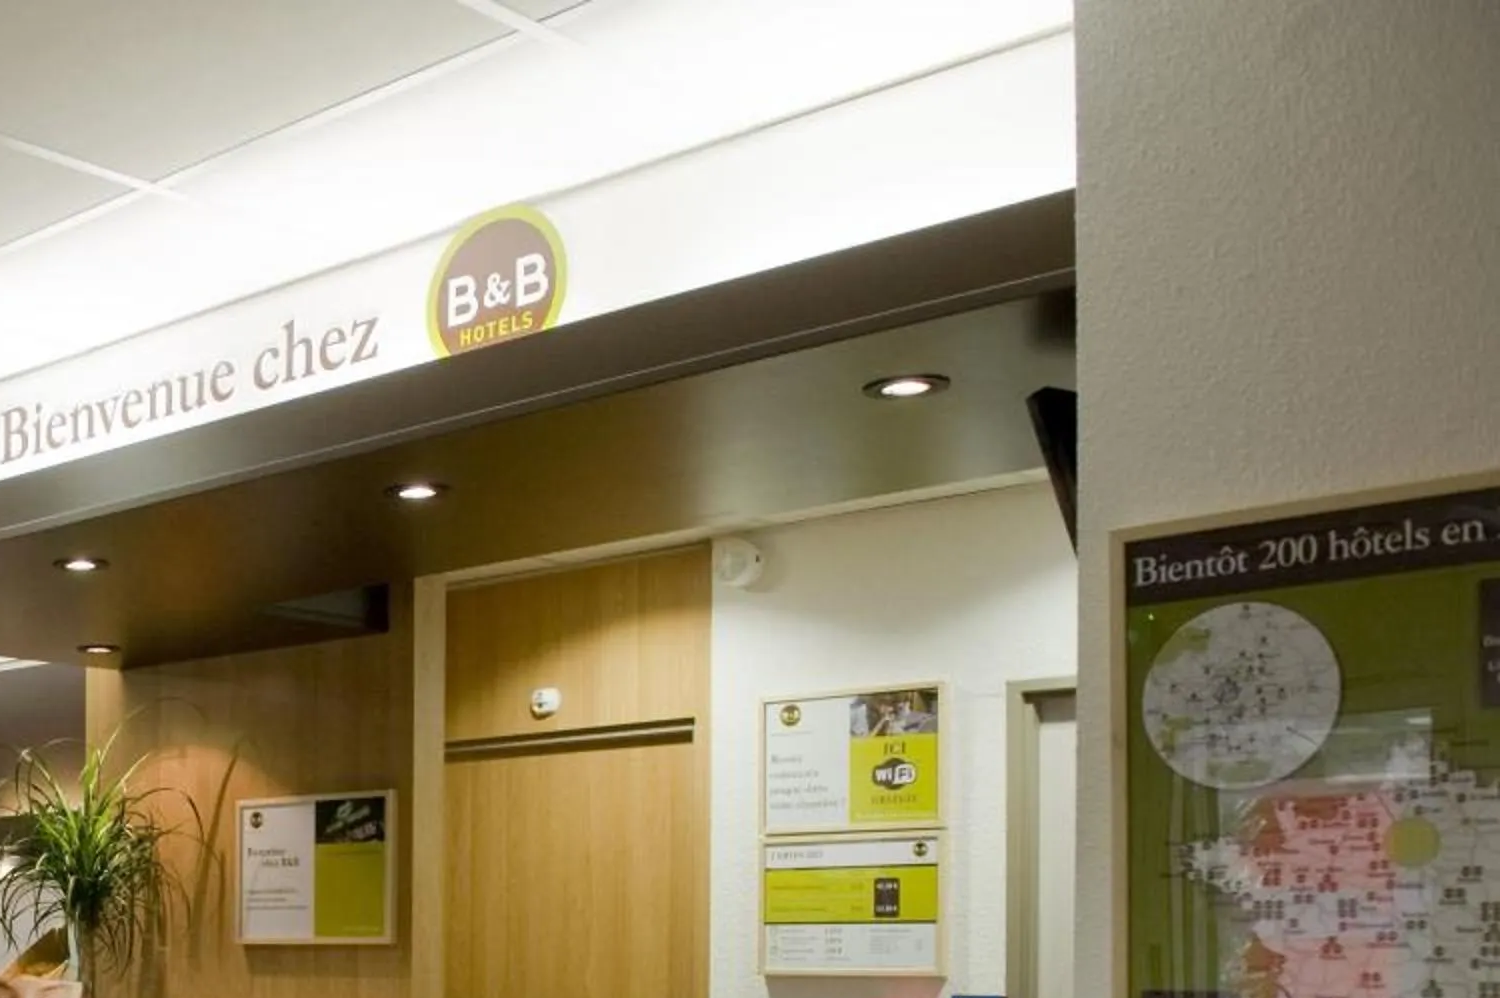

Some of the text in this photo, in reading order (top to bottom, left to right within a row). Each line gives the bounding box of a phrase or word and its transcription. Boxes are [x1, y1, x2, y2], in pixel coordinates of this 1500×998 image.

[447, 253, 549, 328] B&B
[460, 311, 534, 347] HOTELS
[0, 313, 381, 466] Bienvenue chez
[1134, 518, 1486, 588] Bientôt 200 hôtels en
